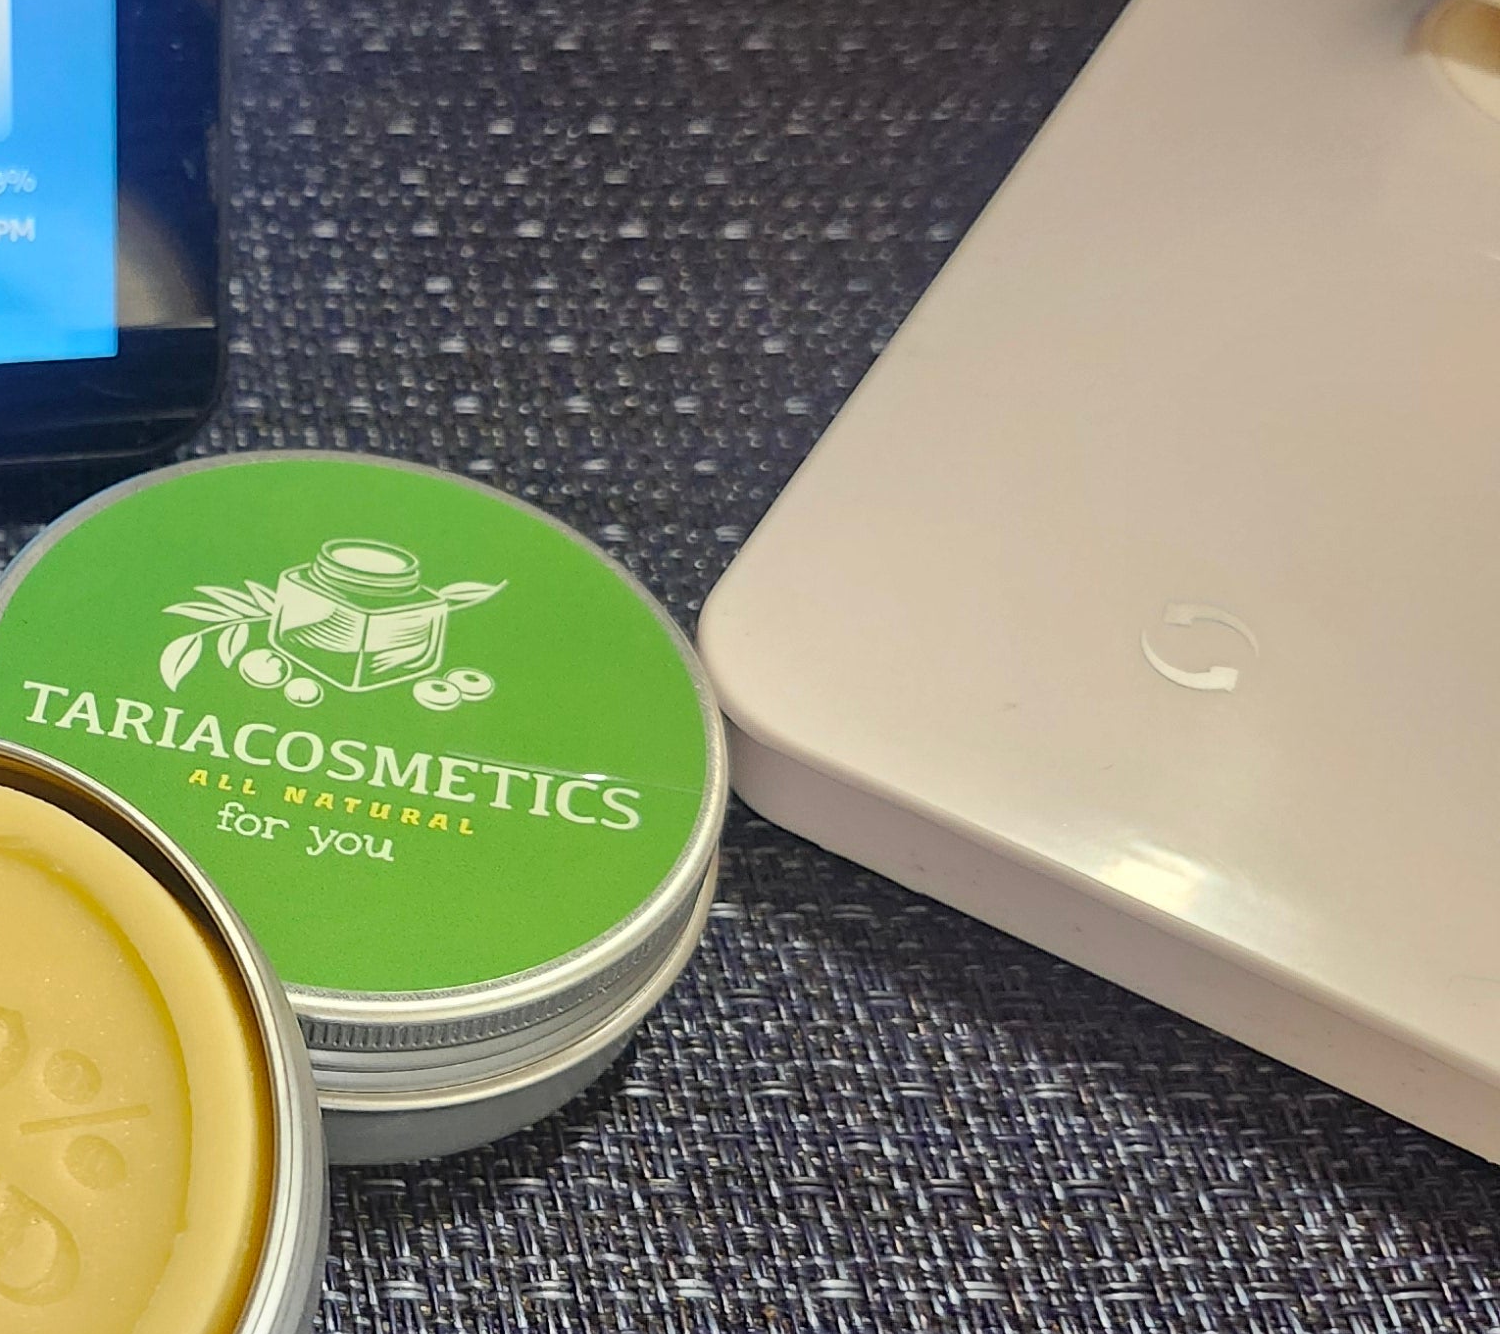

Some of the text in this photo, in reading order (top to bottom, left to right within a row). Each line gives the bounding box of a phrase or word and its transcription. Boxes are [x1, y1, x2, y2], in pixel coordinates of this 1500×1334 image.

[23, 680, 642, 831] TARIACOSMETICS
[189, 768, 475, 835] ALL NATURAL
[216, 801, 396, 862] for you
